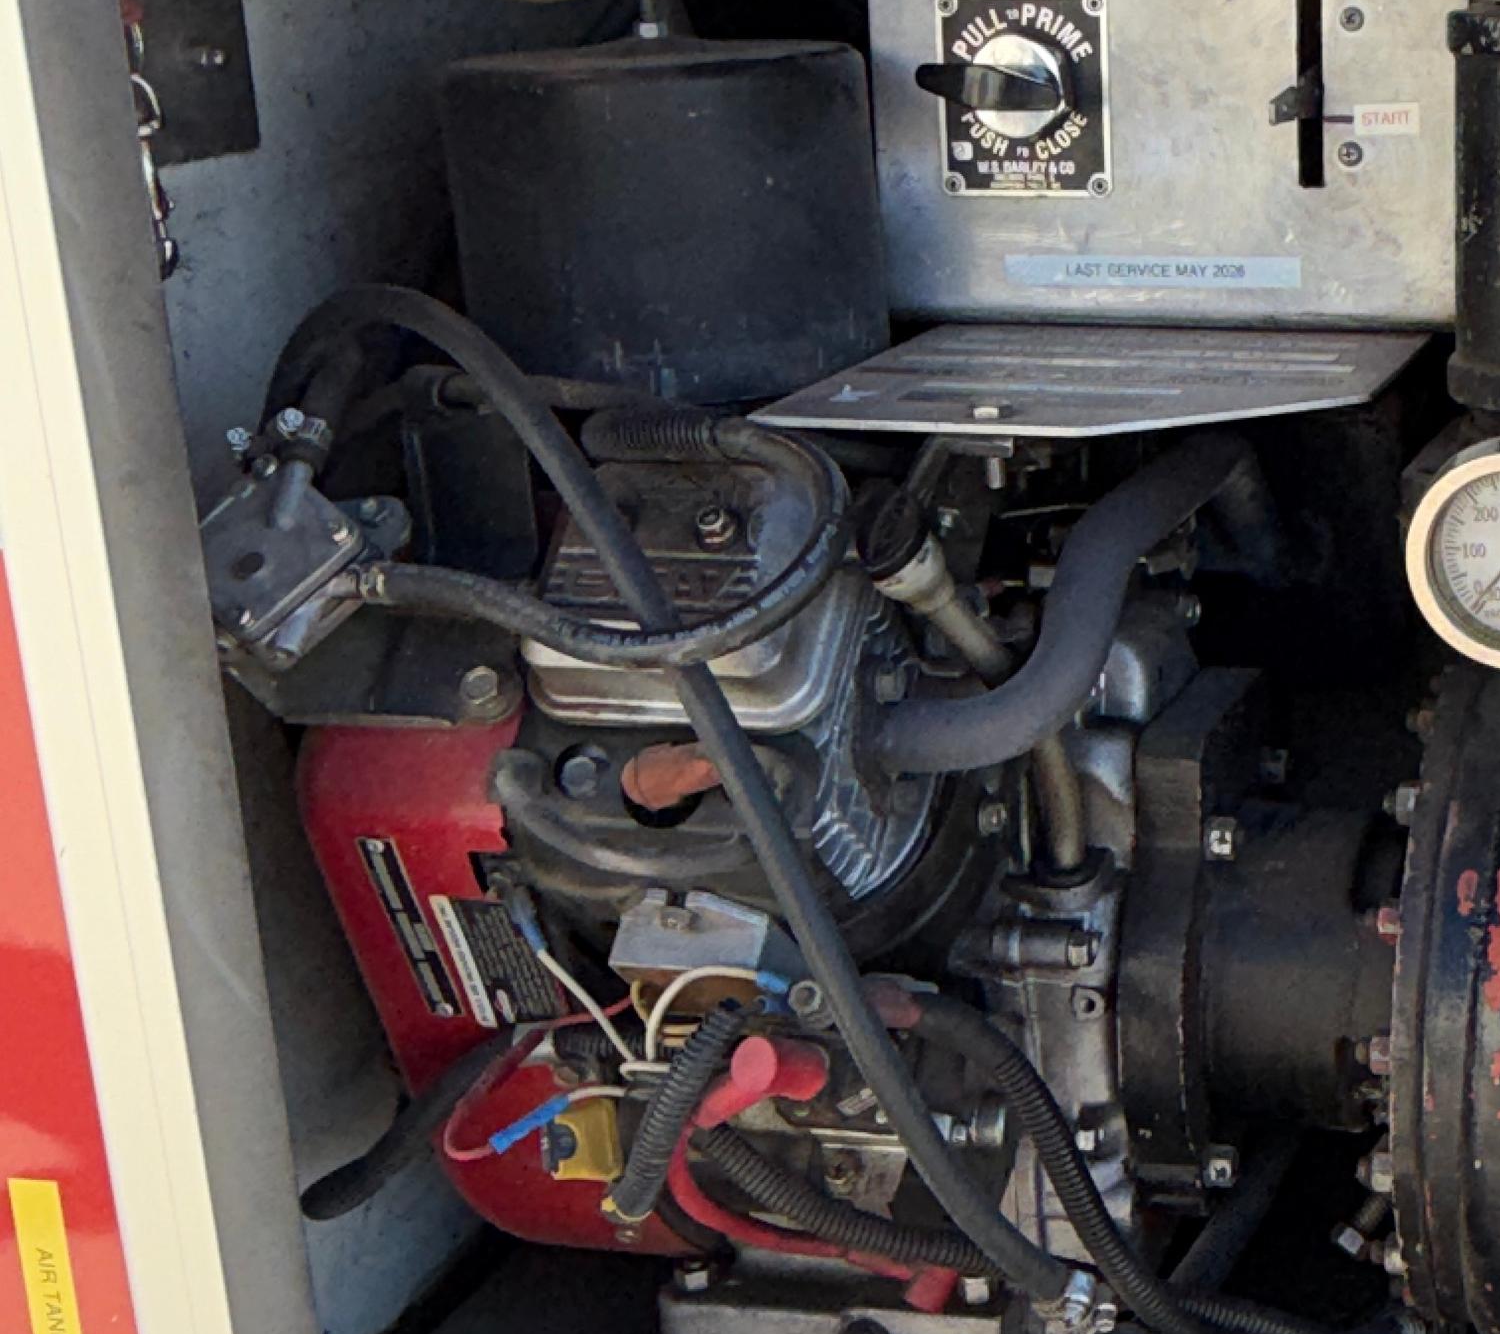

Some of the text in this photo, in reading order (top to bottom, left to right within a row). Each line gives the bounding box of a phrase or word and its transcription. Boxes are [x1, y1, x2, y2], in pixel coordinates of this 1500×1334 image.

[952, 8, 1008, 61] PULL
[1020, 3, 1093, 63] PRIME
[1361, 110, 1411, 127] START
[961, 110, 1010, 157] PUSH
[1035, 110, 1088, 159] CLOSE
[1066, 262, 1102, 278] LAST
[1107, 262, 1172, 279] SERVICE
[1175, 264, 1209, 278] MAY
[1473, 507, 1499, 522] 200
[1462, 543, 1487, 558] 100
[35, 1247, 58, 1284] AIR
